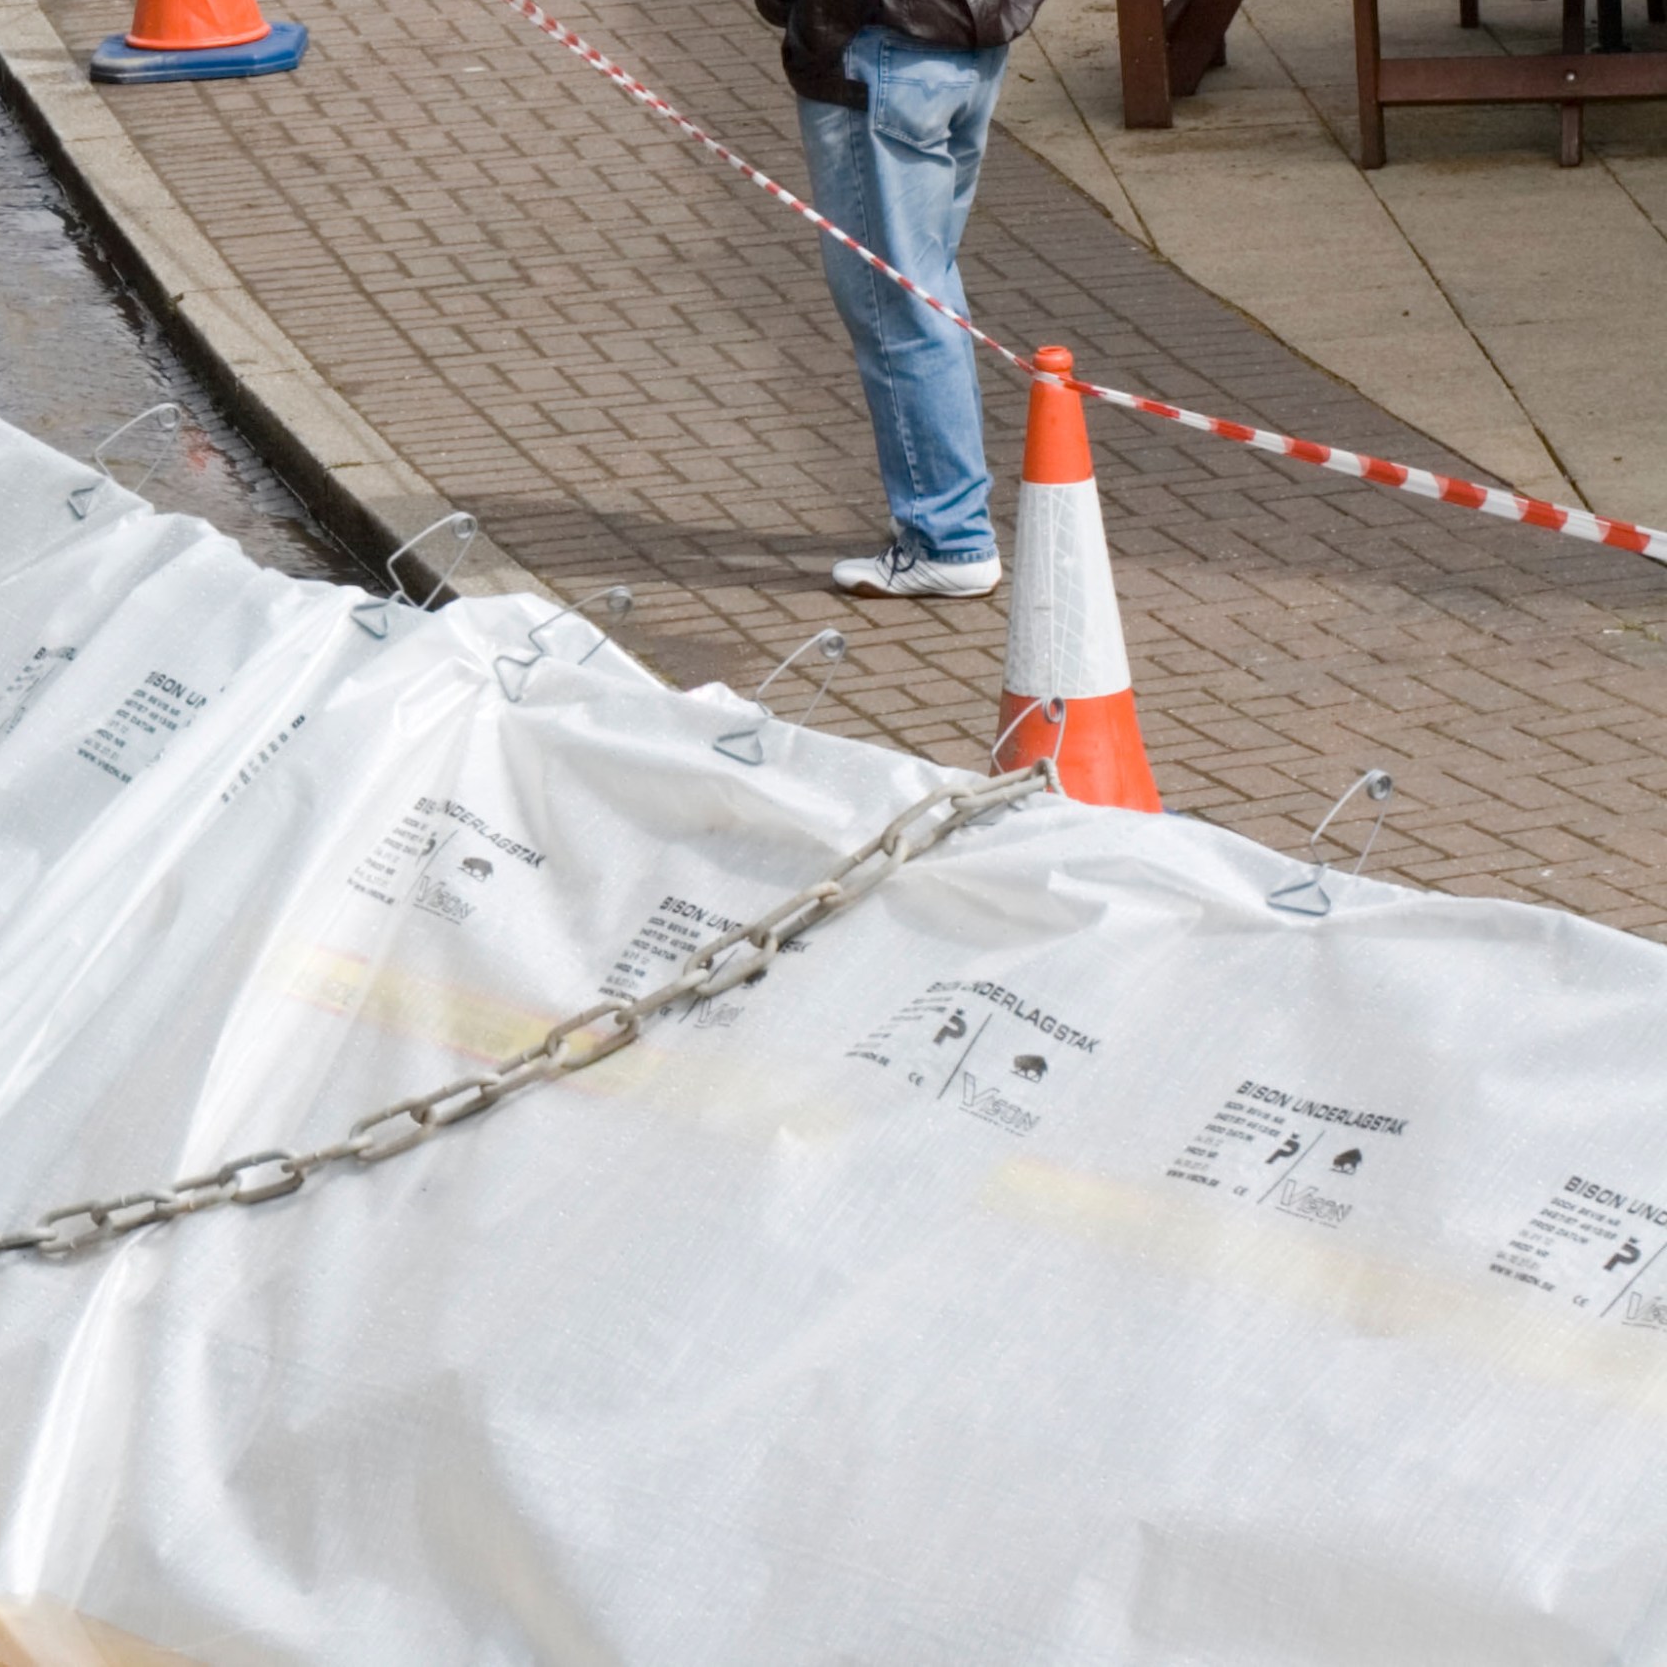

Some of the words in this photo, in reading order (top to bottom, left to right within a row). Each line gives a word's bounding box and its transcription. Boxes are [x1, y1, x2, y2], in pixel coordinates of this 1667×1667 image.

[659, 896, 707, 922] BISON
[1236, 1080, 1293, 1109] BISON
[1291, 1098, 1409, 1135] UNDERLAGSTAK
[1564, 1175, 1627, 1209] BISON
[1572, 1294, 1589, 1308] CE
